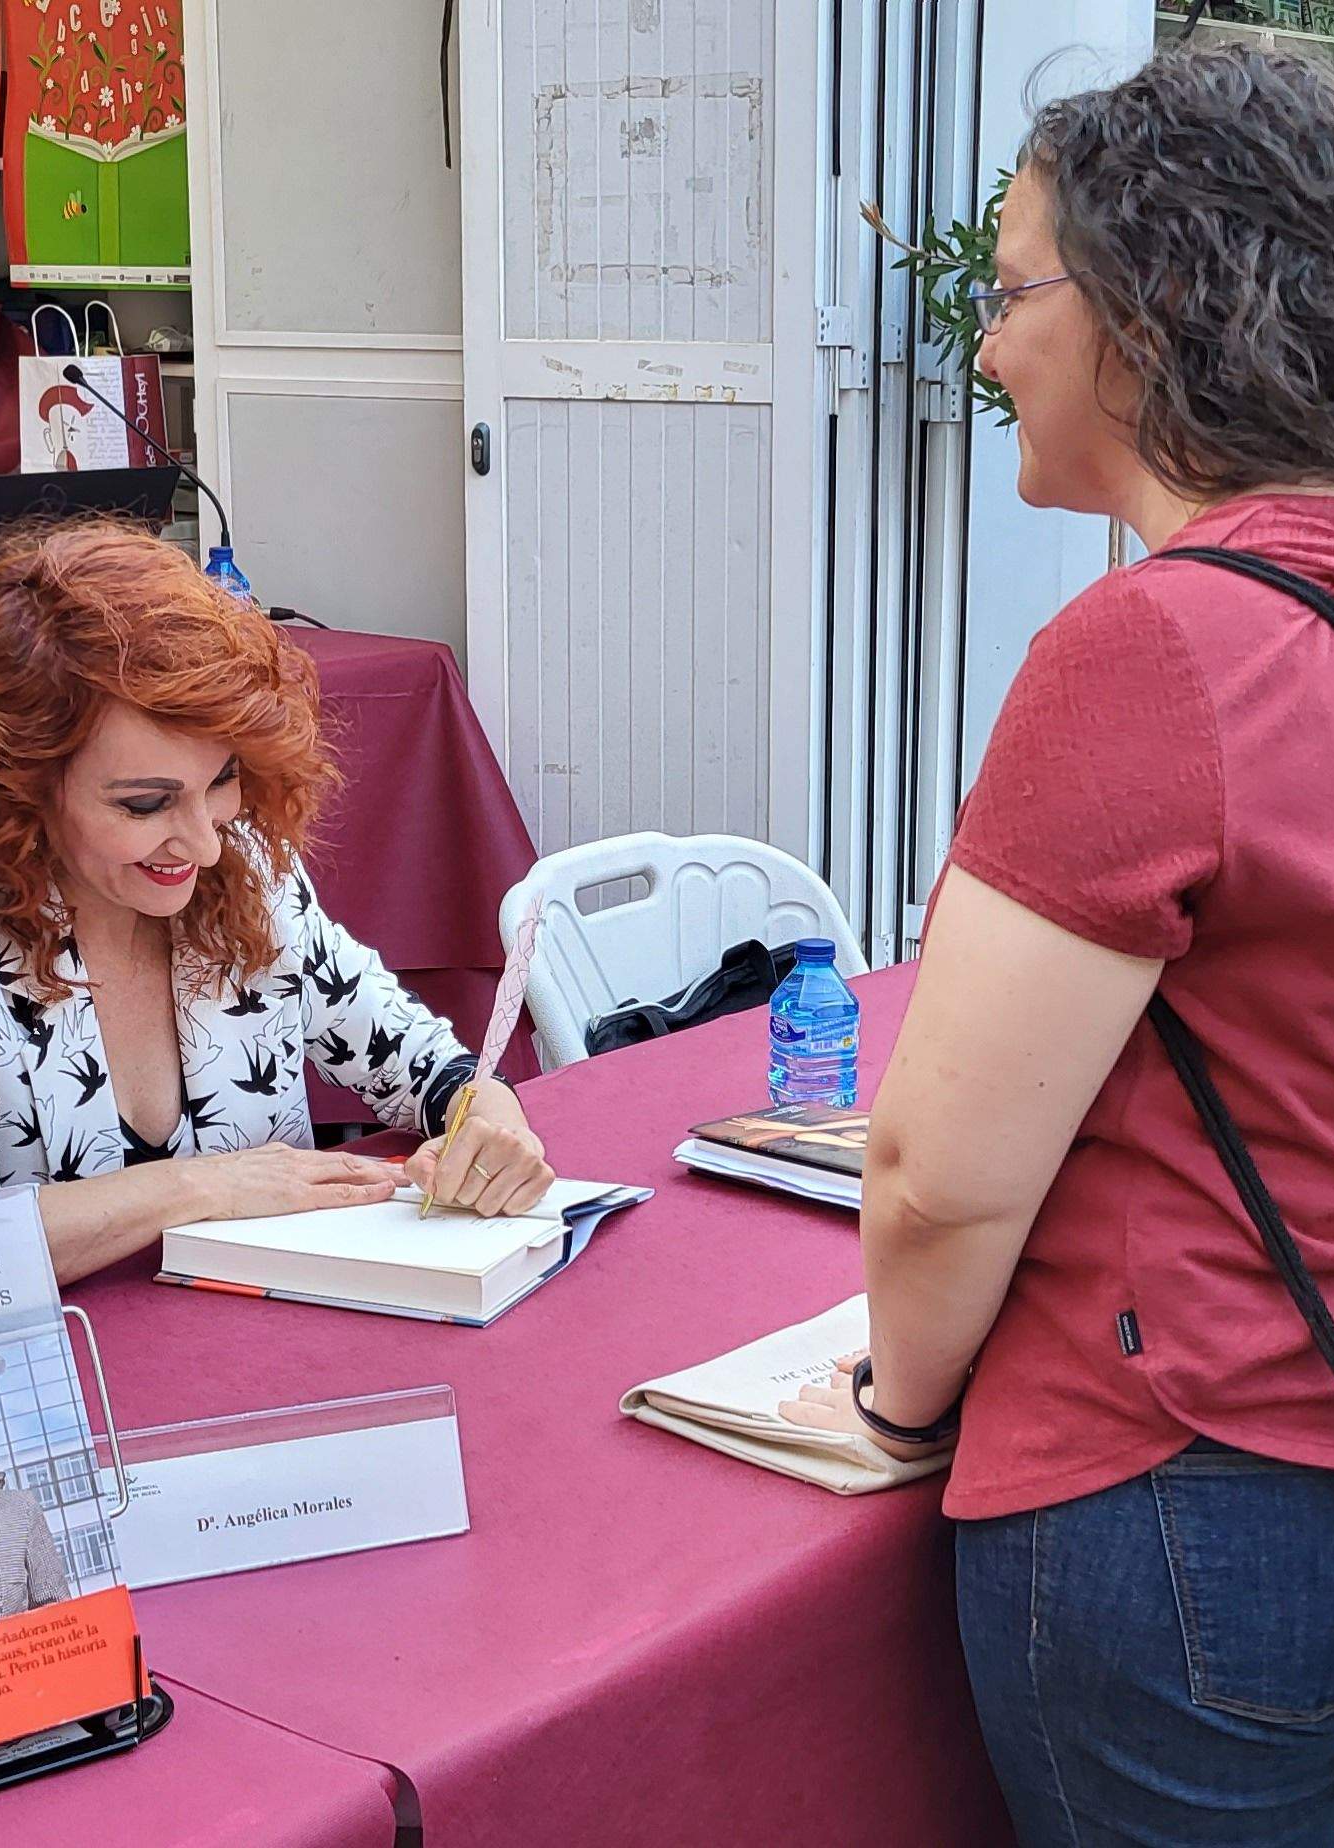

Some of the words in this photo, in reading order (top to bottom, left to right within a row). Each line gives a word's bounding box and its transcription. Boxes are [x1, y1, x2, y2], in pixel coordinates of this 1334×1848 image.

[769, 1371, 801, 1384] THE
[224, 1507, 289, 1528] Angélica
[293, 1496, 353, 1517] Morales
[50, 1614, 78, 1631] más
[67, 1629, 84, 1642] de
[86, 1624, 99, 1637] la
[9, 1659, 40, 1676] Pero
[42, 1653, 55, 1666] la
[57, 1638, 107, 1661] historia
